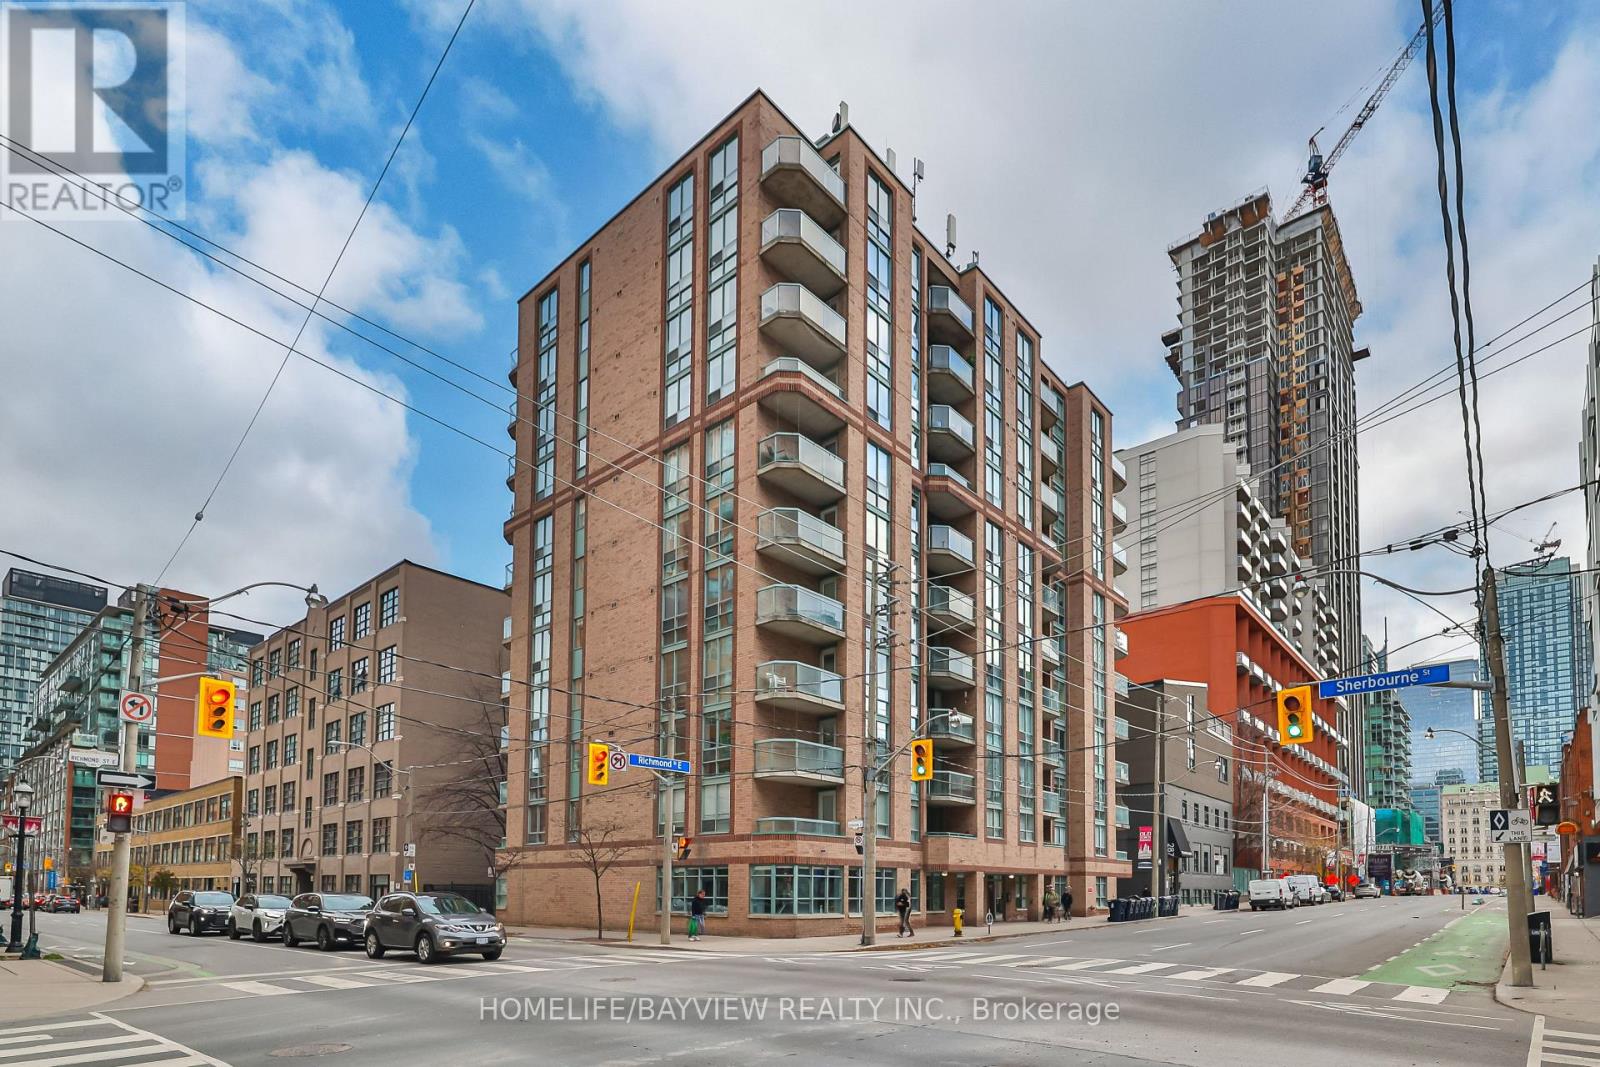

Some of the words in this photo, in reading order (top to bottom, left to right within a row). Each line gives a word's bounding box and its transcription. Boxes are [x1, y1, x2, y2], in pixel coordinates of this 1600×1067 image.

[1336, 672, 1419, 693] Sherbourne
[1422, 668, 1431, 676] St
[638, 756, 672, 768] Richmond
[677, 761, 682, 769] E
[1167, 843, 1175, 857] 287
